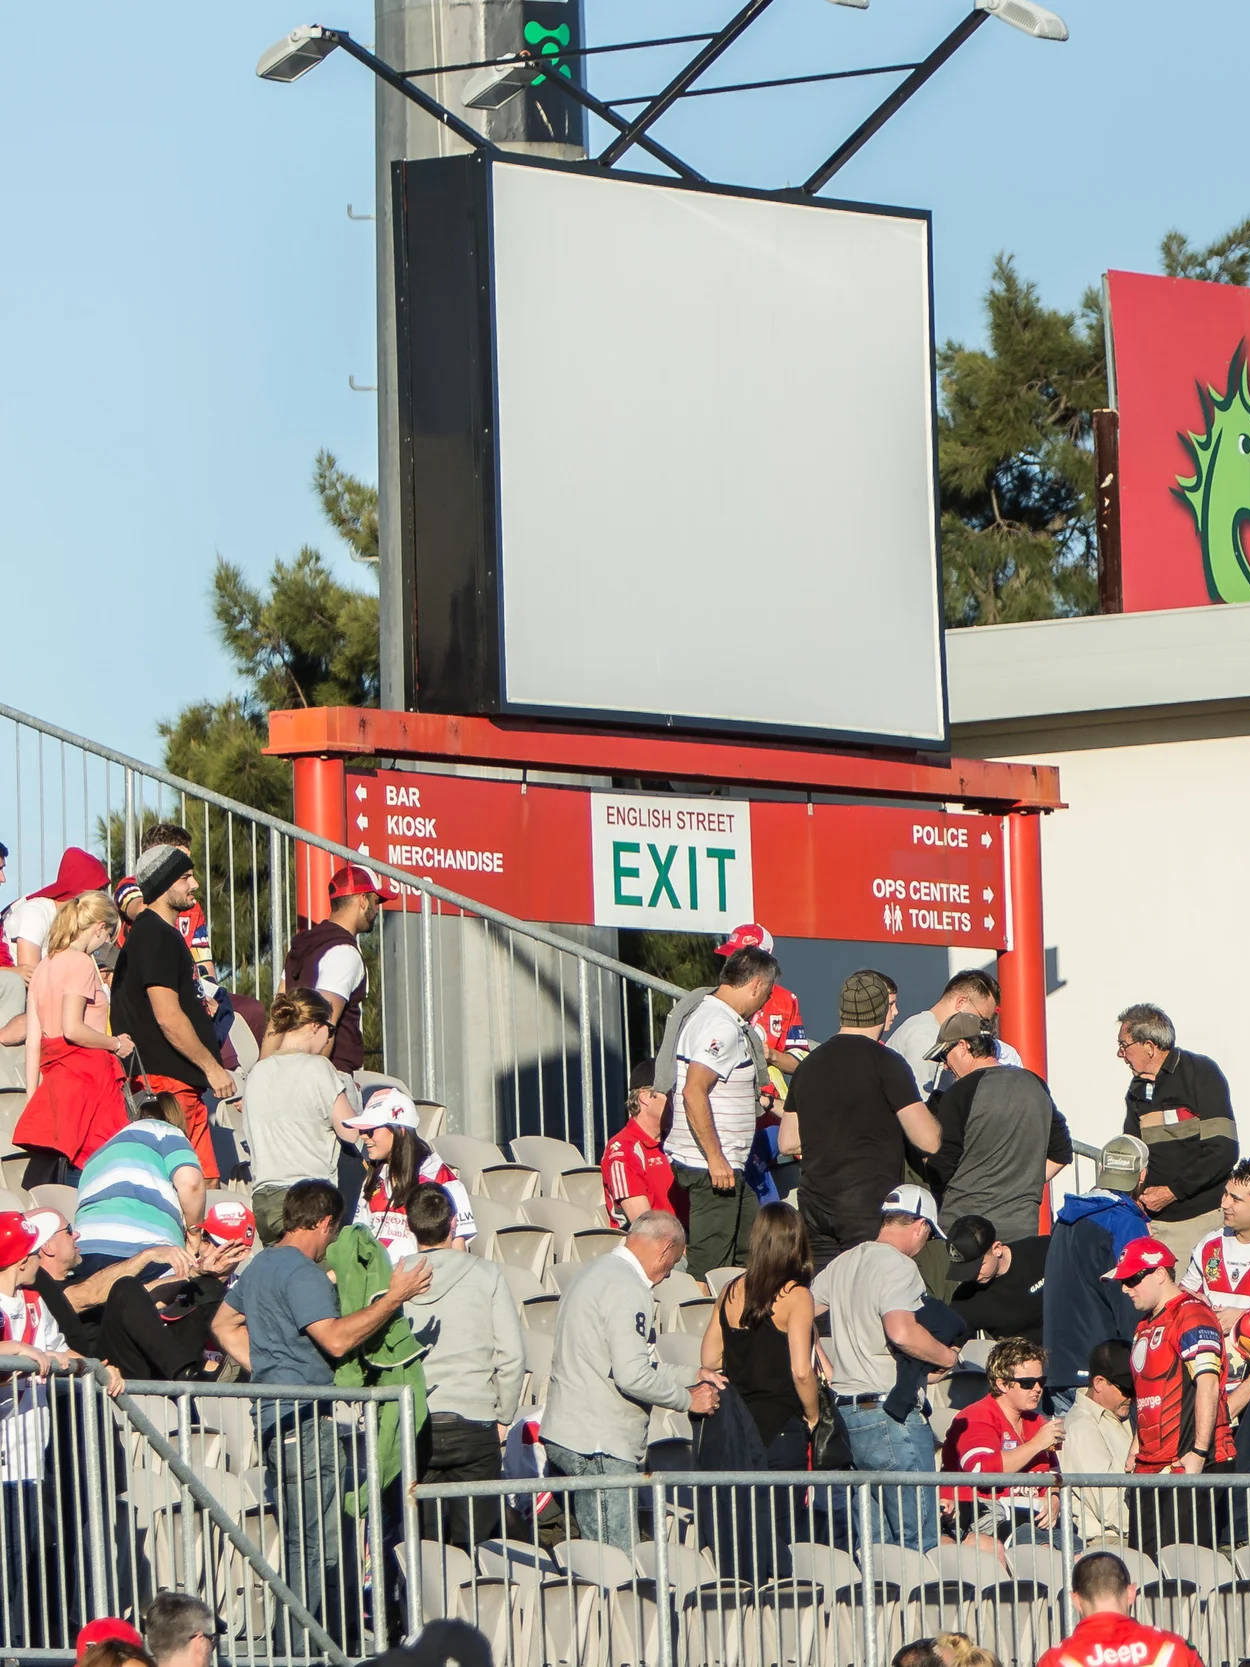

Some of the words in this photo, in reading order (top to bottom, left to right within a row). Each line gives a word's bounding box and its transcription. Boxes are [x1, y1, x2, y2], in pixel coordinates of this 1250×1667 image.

[386, 785, 421, 808] BAR
[387, 815, 437, 839] KIOSK
[606, 805, 671, 828] ENGLISH
[676, 810, 735, 833] STREET
[913, 824, 969, 848] POLICE
[388, 844, 504, 873] MERCHANDISE
[612, 840, 736, 912] EXIT
[872, 878, 906, 899] OPS
[909, 881, 971, 904] CENTRE
[909, 908, 972, 931] TOILETS
[635, 1311, 646, 1338] 8
[1086, 1641, 1148, 1667] Jeep
